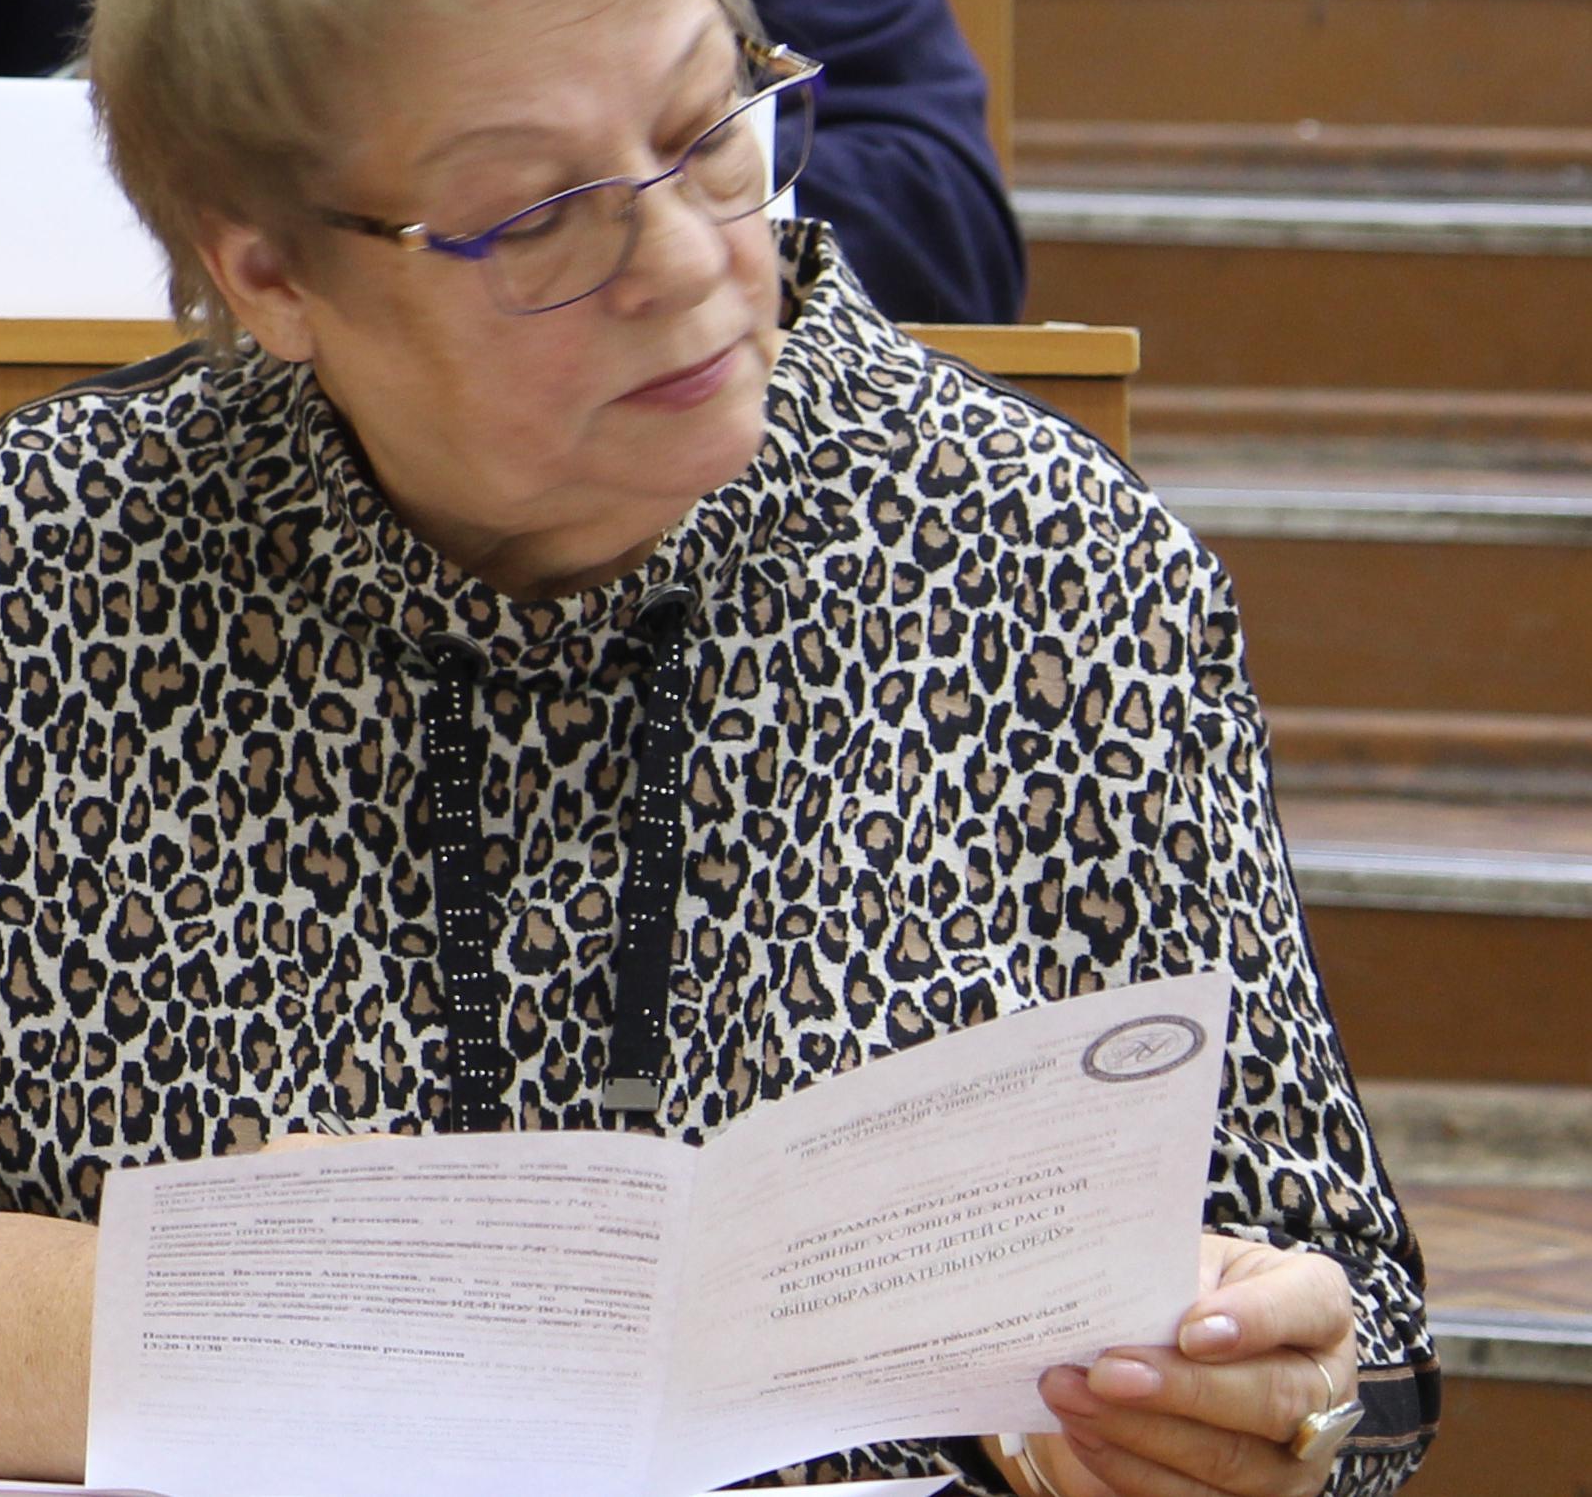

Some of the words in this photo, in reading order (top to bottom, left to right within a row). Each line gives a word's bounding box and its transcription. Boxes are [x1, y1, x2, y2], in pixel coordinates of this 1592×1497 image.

[761, 1237, 870, 1280] «ОСНОВНЫЕ
[874, 1213, 962, 1246] УСЛОВИЯ
[965, 1177, 1089, 1220] БЕЗОПАСНОЙ
[778, 1243, 932, 1295] ВКЛЮЧЕННОСТИ
[935, 1221, 995, 1253] ДЕТЕЙ
[997, 1218, 1011, 1233] С
[1014, 1209, 1050, 1228] РАС
[1052, 1204, 1066, 1217] В
[787, 1211, 899, 1253] ПРОГРАММА
[904, 1182, 1000, 1218] КРУГЛОГО
[1002, 1165, 1065, 1191] СТОЛА
[770, 1245, 1007, 1320] ОБЩЕОБРАЗОВАТЕЛЬНУЮ
[1009, 1225, 1075, 1255] СРЕДУ»
